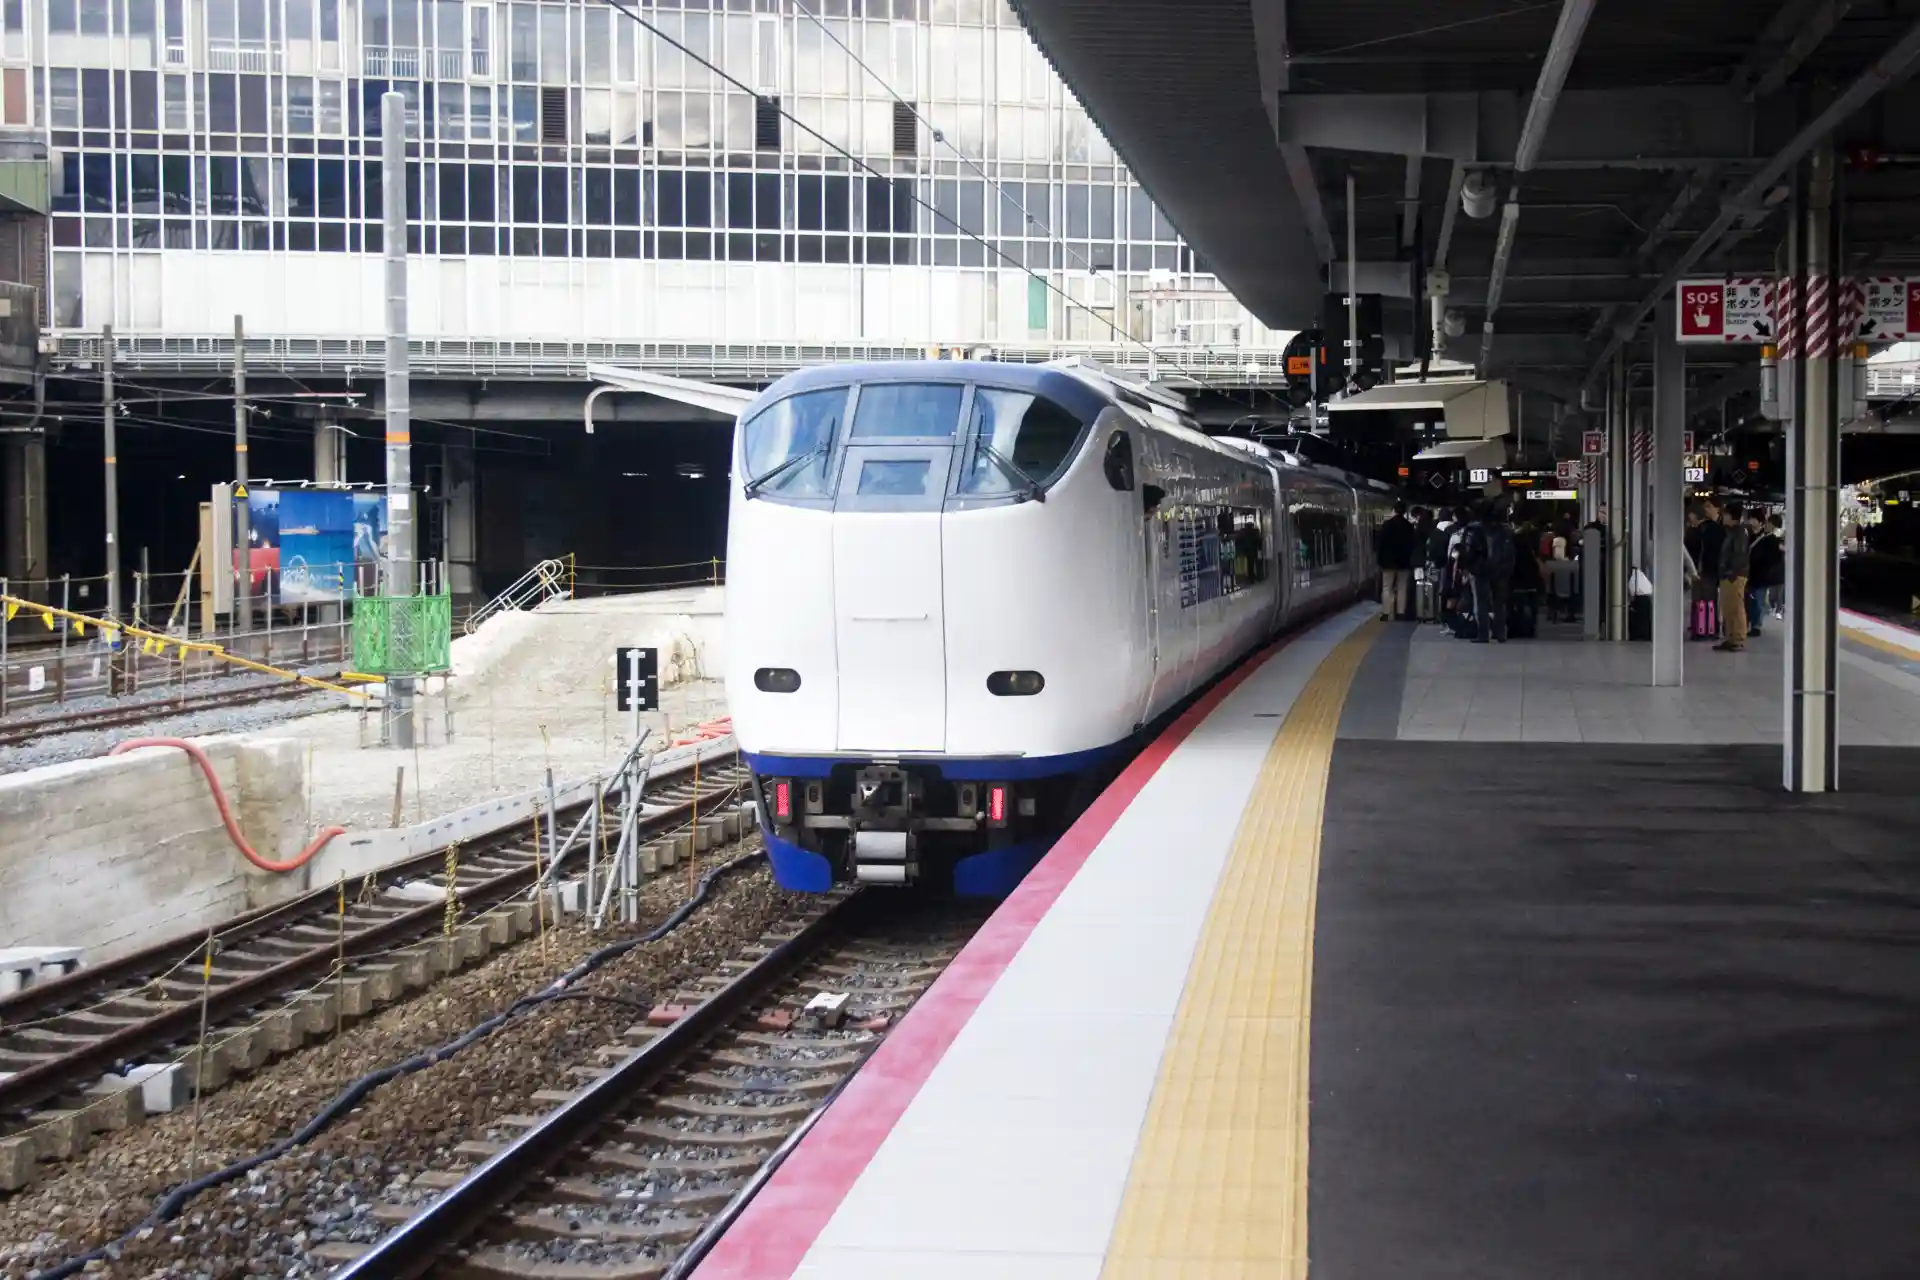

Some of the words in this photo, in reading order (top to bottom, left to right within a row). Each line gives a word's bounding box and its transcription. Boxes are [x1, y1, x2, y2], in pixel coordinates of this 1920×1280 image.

[1687, 292, 1719, 303] SOS
[1726, 299, 1760, 309] ボタン
[1473, 471, 1485, 481] 11
[1687, 469, 1701, 480] 12
